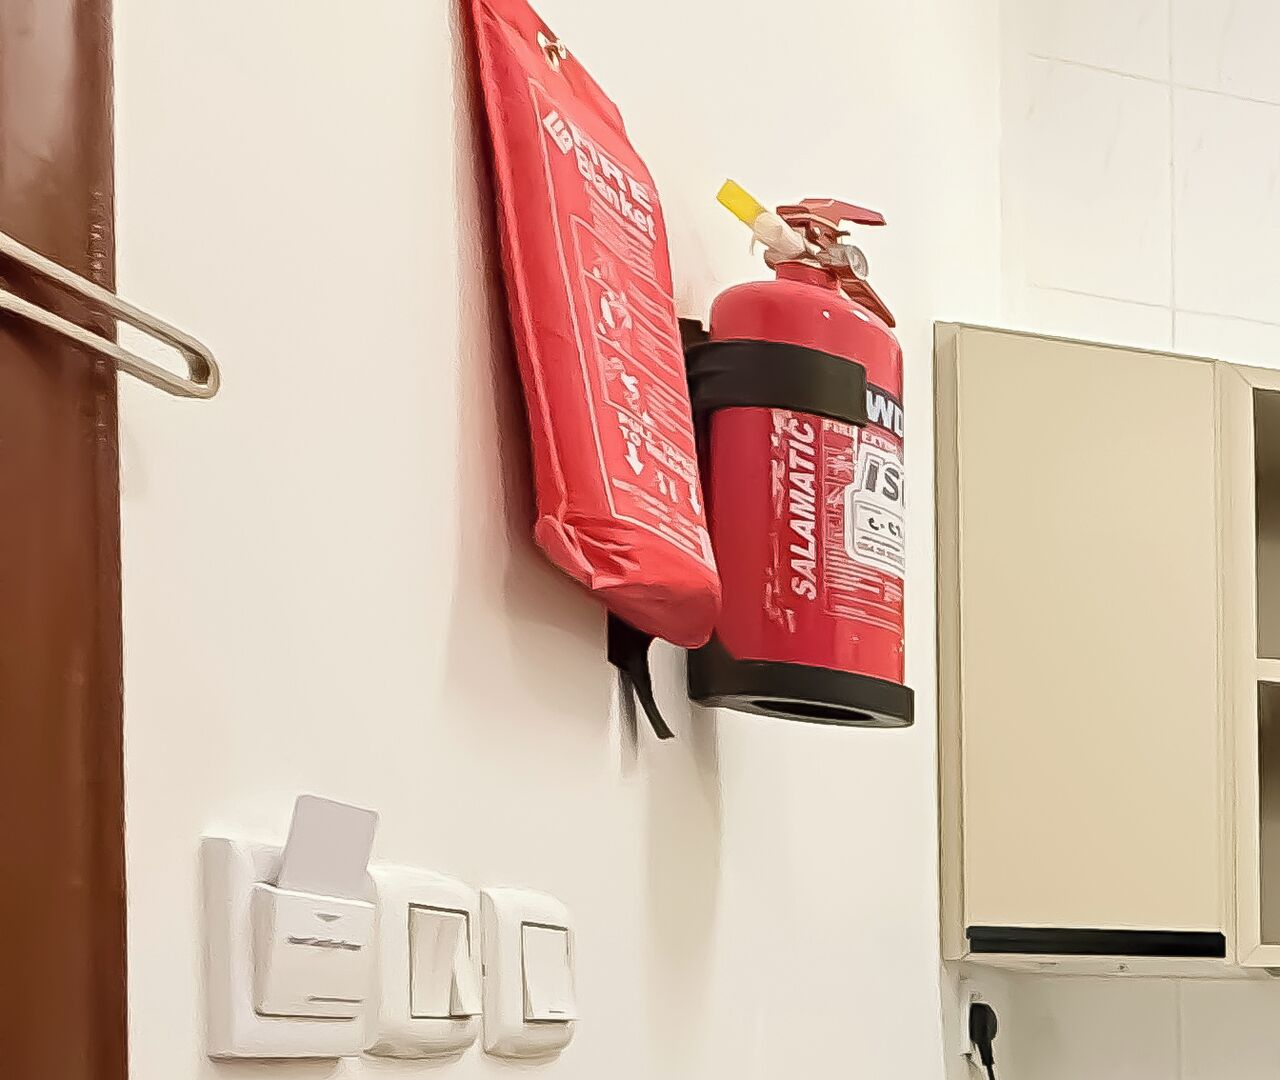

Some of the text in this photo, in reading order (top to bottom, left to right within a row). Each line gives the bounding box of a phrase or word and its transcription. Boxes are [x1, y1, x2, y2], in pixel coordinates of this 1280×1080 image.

[568, 121, 656, 213] FIRE
[574, 145, 656, 241] Blanket
[789, 421, 817, 601] SALAMATIC
